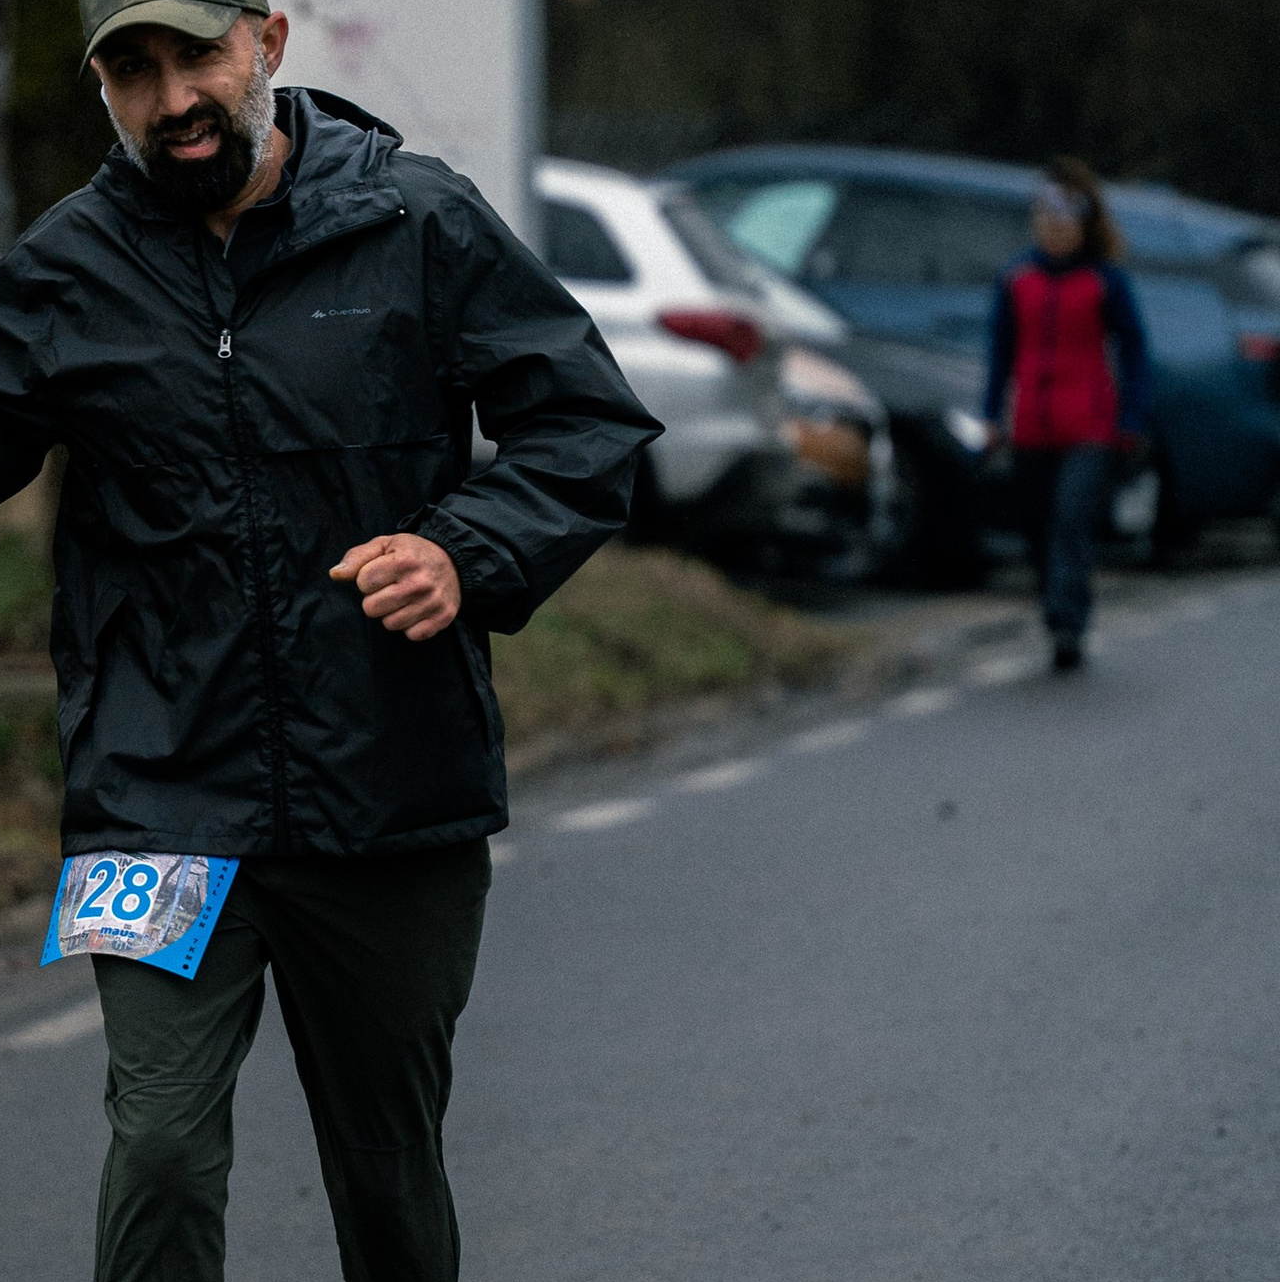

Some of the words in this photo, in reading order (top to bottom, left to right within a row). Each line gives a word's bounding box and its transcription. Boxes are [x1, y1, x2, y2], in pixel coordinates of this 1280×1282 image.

[328, 308, 371, 316] Quechua
[76, 859, 160, 921] 28
[198, 905, 212, 929] RUN
